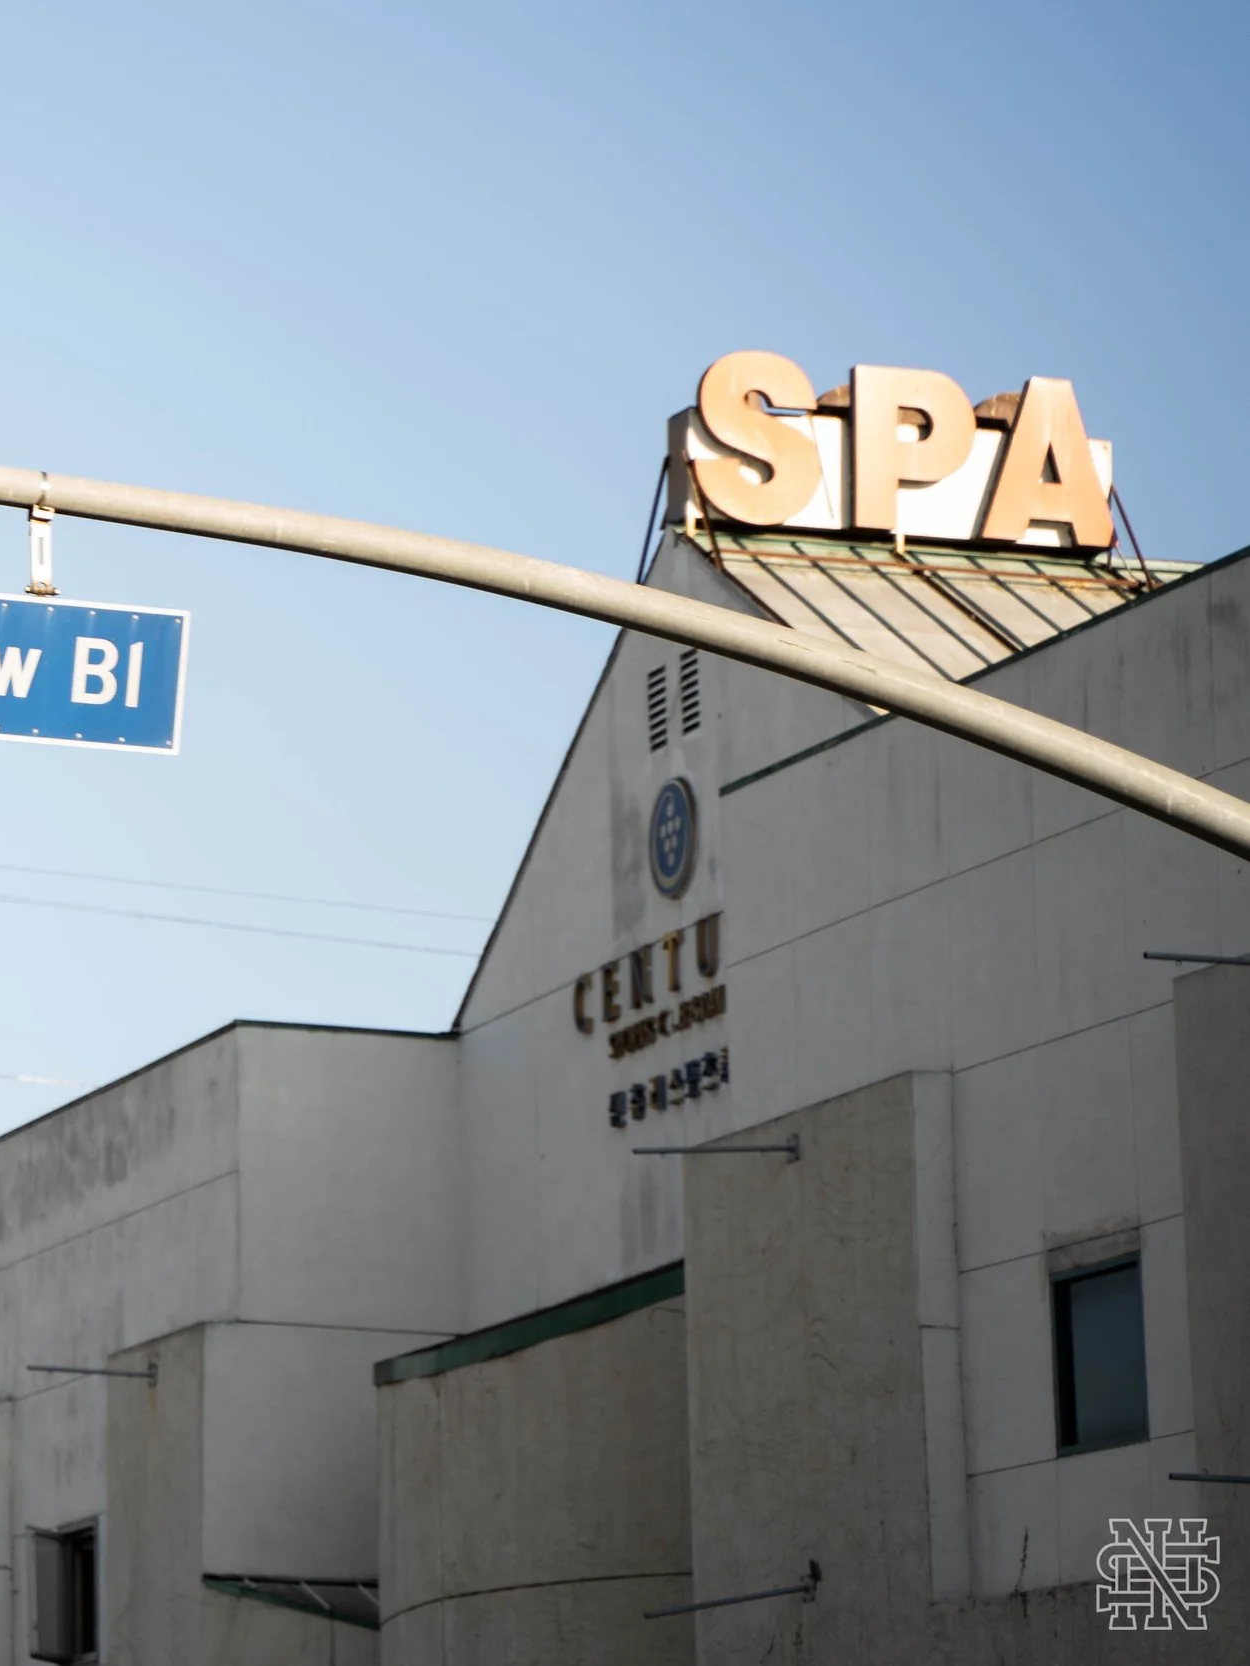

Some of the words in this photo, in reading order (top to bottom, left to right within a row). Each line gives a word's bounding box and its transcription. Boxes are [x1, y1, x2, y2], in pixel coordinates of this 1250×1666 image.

[691, 350, 1115, 549] SPA
[70, 636, 144, 708] Bl
[573, 914, 720, 1035] CENTU
